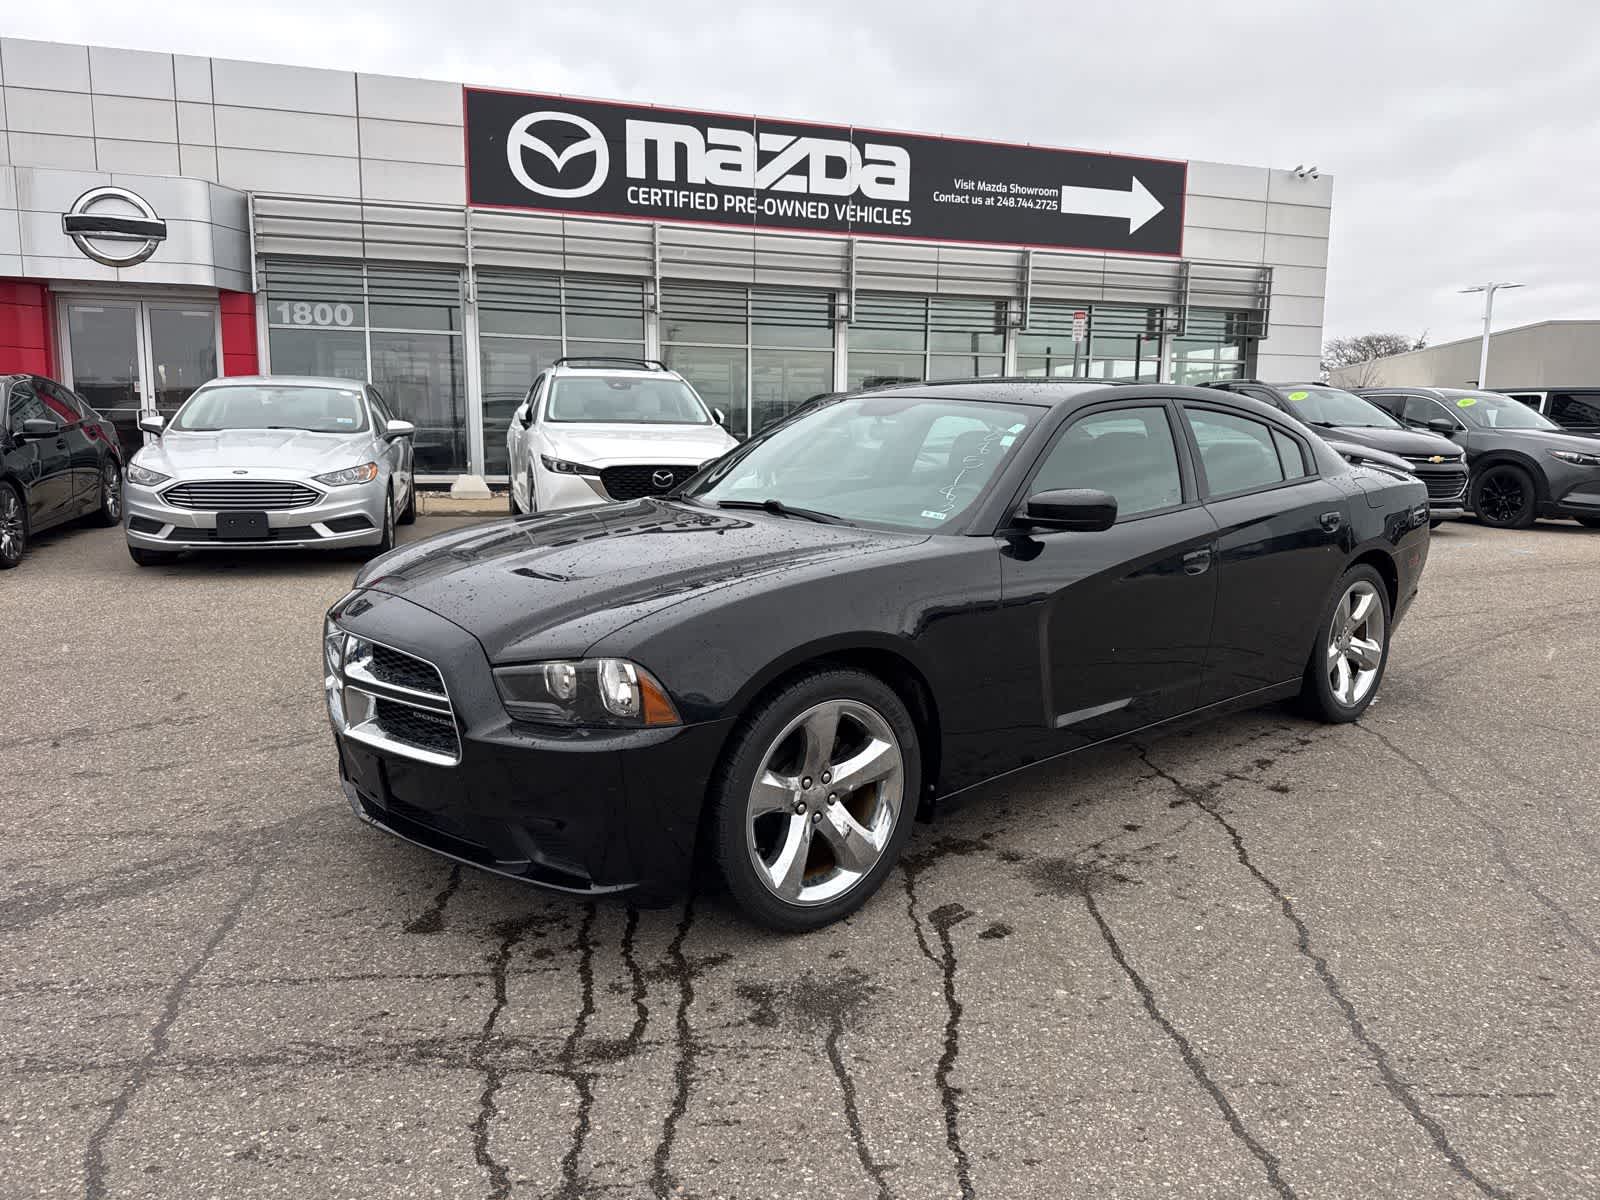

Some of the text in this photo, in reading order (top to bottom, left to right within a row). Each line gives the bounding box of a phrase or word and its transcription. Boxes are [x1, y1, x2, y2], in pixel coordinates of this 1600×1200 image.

[953, 178, 1059, 197] Visit Mazda Showroom
[627, 186, 912, 226] CERTIFIED PRE-OWNED VEHICLES
[933, 191, 1058, 211] Contact us at 248.744.2725
[276, 301, 354, 326] 1800
